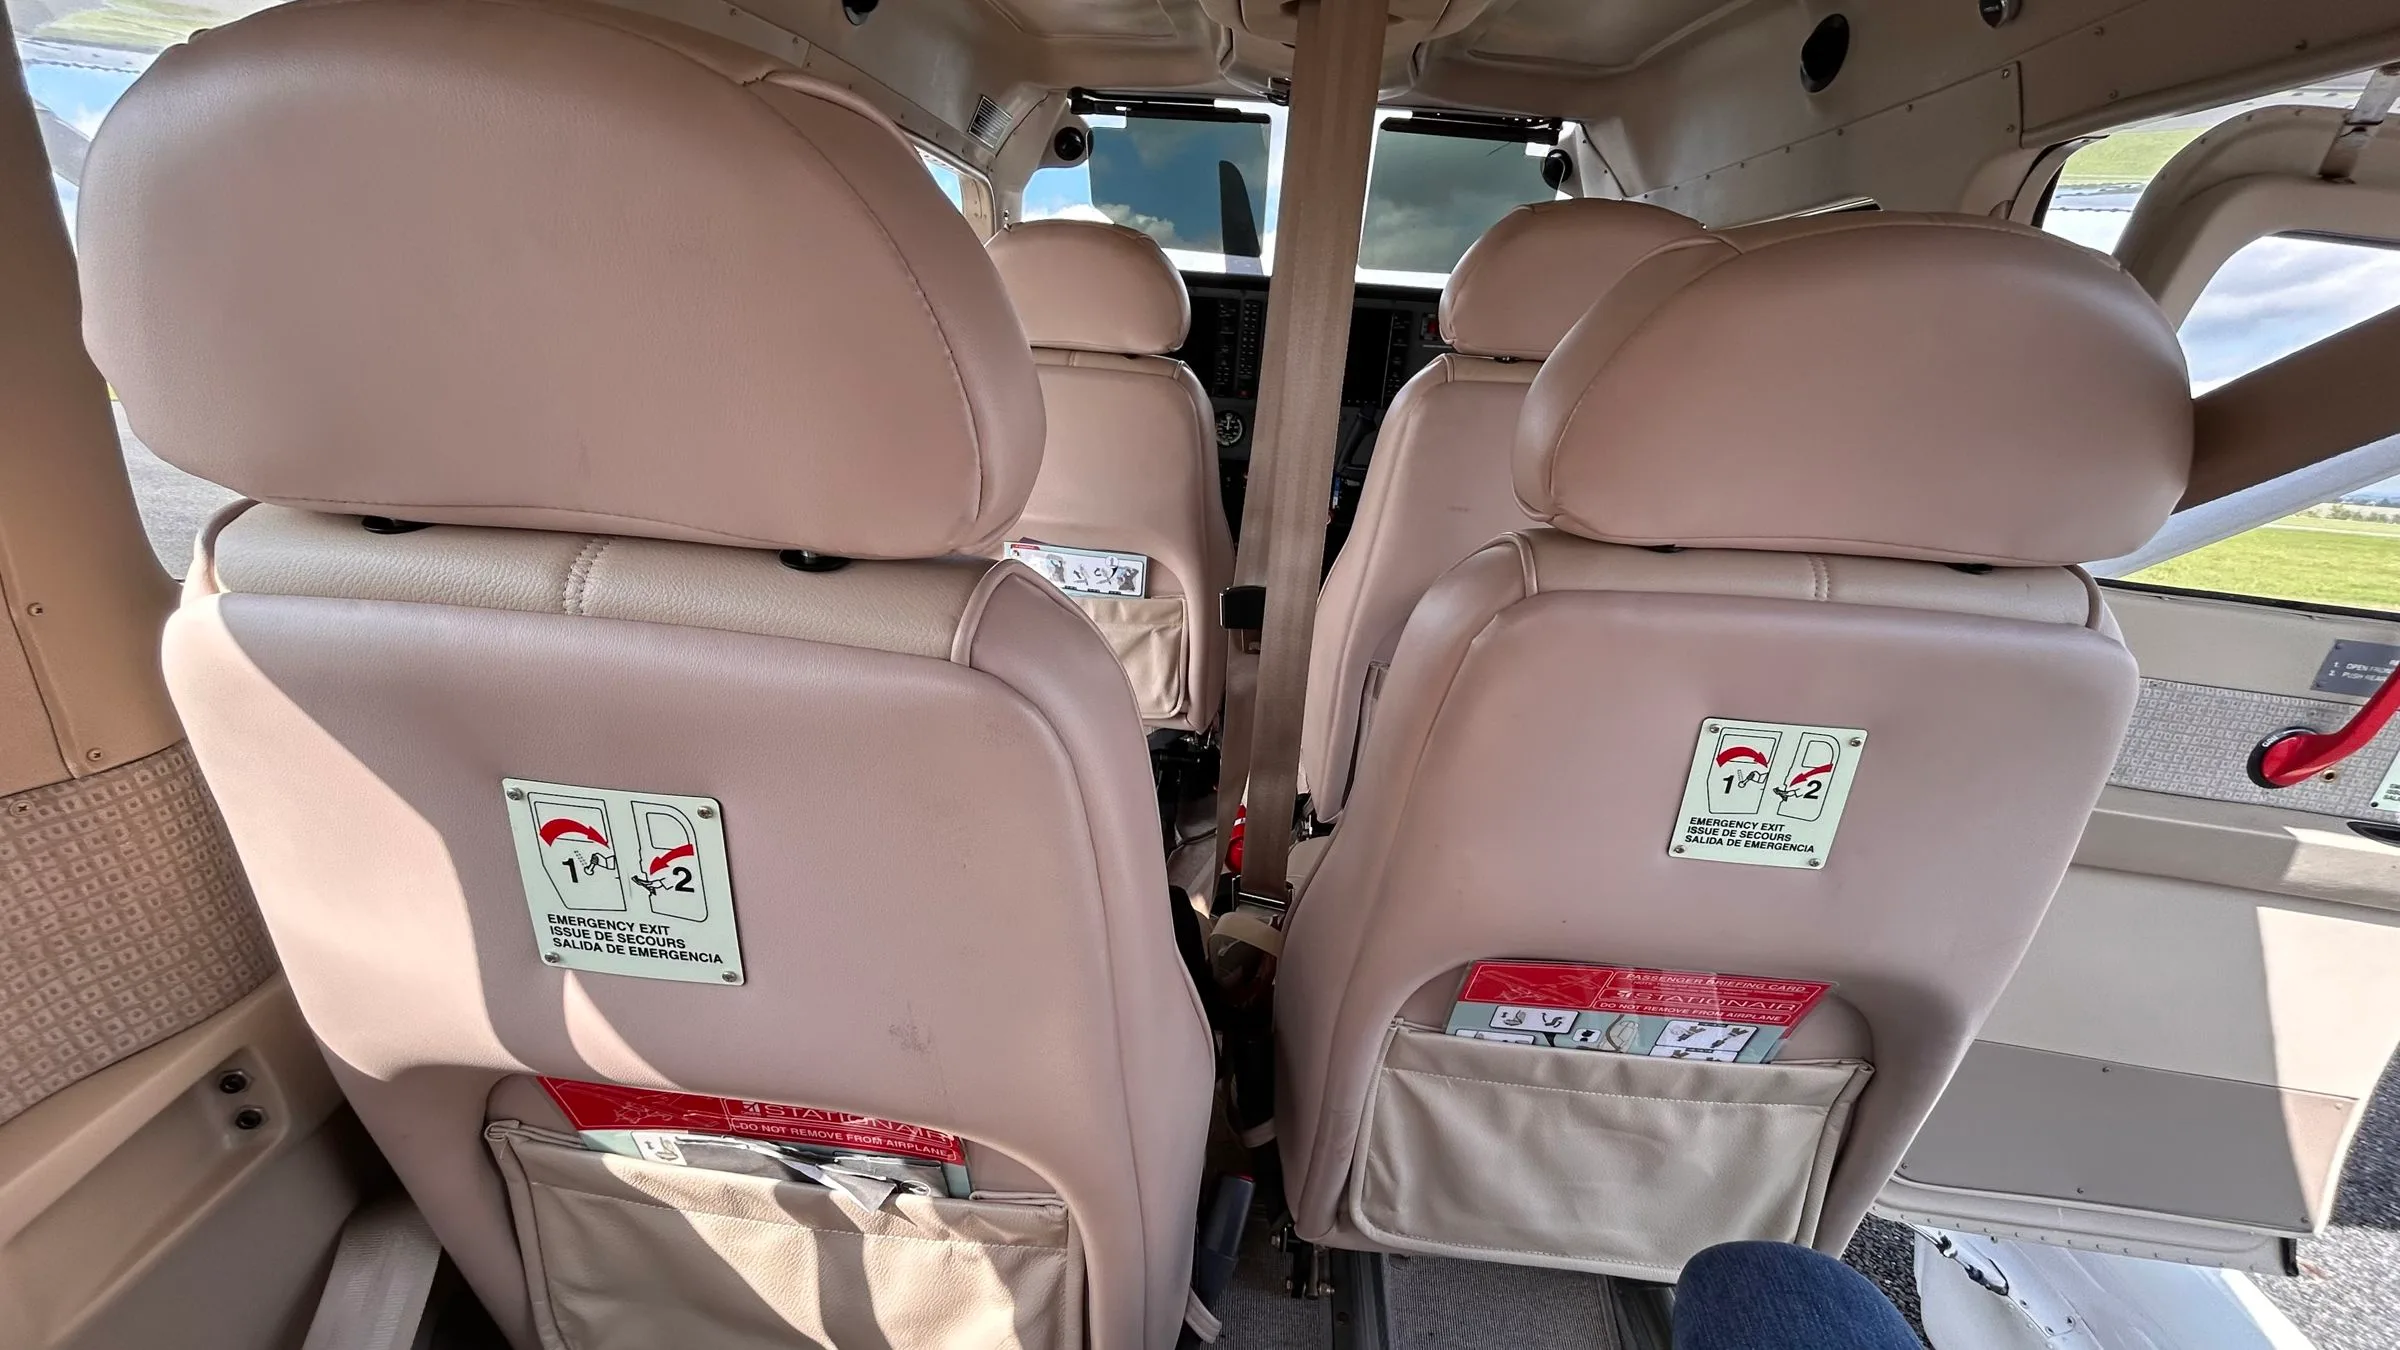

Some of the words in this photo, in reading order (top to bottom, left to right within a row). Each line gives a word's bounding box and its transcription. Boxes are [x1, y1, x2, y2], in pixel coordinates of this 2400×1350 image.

[1722, 775, 1734, 794] 1
[1803, 780, 1822, 799] 2
[1690, 816, 1759, 830] EMERGENCY
[1760, 822, 1785, 832] EXIT
[1684, 834, 1723, 846] SALIDA
[1726, 838, 1742, 847] DE
[1743, 840, 1815, 853] EMERGENCIA
[1687, 826, 1720, 836] ISSUE
[1721, 828, 1738, 838] DE
[1739, 830, 1792, 842] SECOURS
[562, 858, 579, 883] 1
[672, 866, 695, 893] 2
[547, 913, 635, 932] EMERGENCY
[639, 923, 671, 936] EXIT
[549, 925, 592, 940] ISSUE
[594, 930, 614, 942] DE
[616, 932, 686, 949] SECOURS
[552, 937, 603, 953] SALIDA
[605, 943, 626, 955] DE
[628, 945, 724, 964] EMERGENCIA
[1625, 973, 1704, 987] PASSENGER
[1705, 977, 1765, 990] BRIEFING
[1768, 984, 1807, 992] CARD
[1634, 992, 1797, 1012] STATIONAIR
[1618, 1003, 1641, 1011] NOT
[1642, 1005, 1690, 1015] REMOVE
[1691, 1009, 1723, 1017] FROM
[1726, 1011, 1784, 1022] AIRPLANE
[740, 1122, 759, 1131] DO
[761, 1124, 787, 1134] NOT
[790, 1127, 843, 1141] REMOVE
[846, 1133, 881, 1145] FROM
[886, 1139, 948, 1156] AIRPLANE
